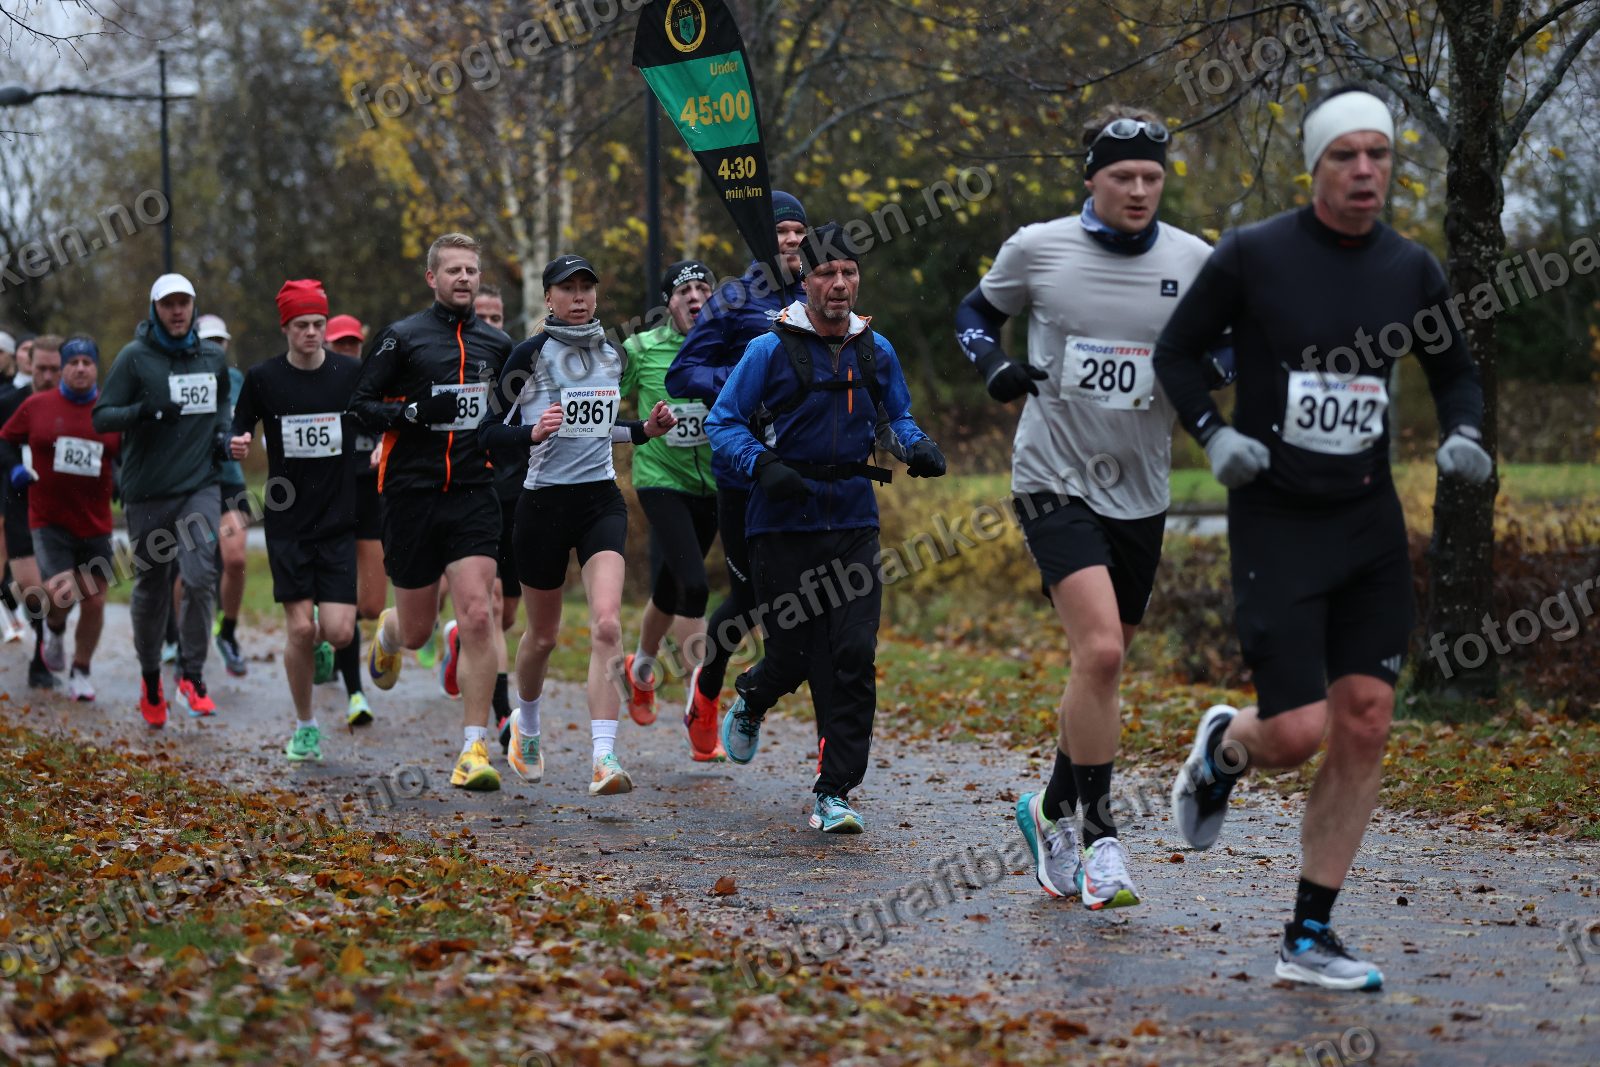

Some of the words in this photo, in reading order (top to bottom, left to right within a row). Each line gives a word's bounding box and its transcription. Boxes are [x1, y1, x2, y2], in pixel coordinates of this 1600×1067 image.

[709, 60, 739, 76] Under
[680, 90, 750, 127] 45:00
[717, 155, 757, 180] 4:30
[725, 186, 763, 202] min/km
[1078, 358, 1136, 393] 280
[180, 385, 209, 406] 562
[567, 390, 617, 398] NORGESTESTEN
[565, 399, 613, 425] 9361
[1296, 395, 1377, 434] 3042
[295, 425, 331, 448] 165
[677, 415, 708, 438] 53
[64, 448, 92, 467] 824
